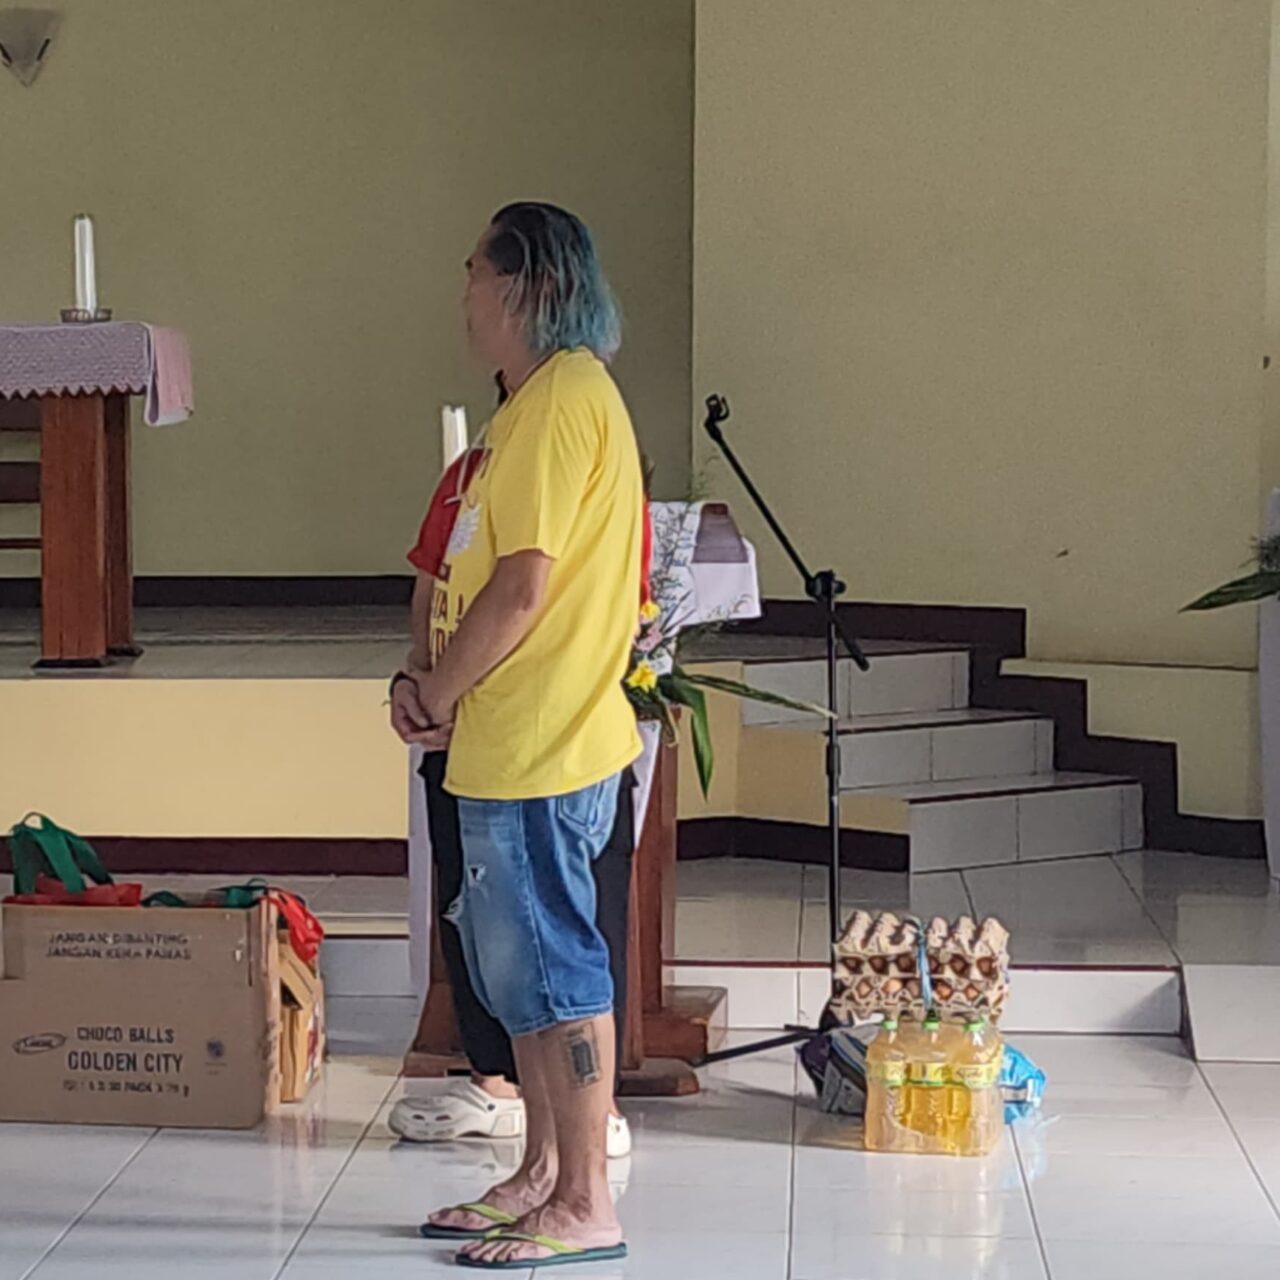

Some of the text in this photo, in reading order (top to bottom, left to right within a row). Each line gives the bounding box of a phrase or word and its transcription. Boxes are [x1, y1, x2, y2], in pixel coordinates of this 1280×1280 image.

[76, 1027, 176, 1044] CHOCO BALLS
[67, 1051, 138, 1073] GOLDEN
[143, 1052, 184, 1074] CITY
